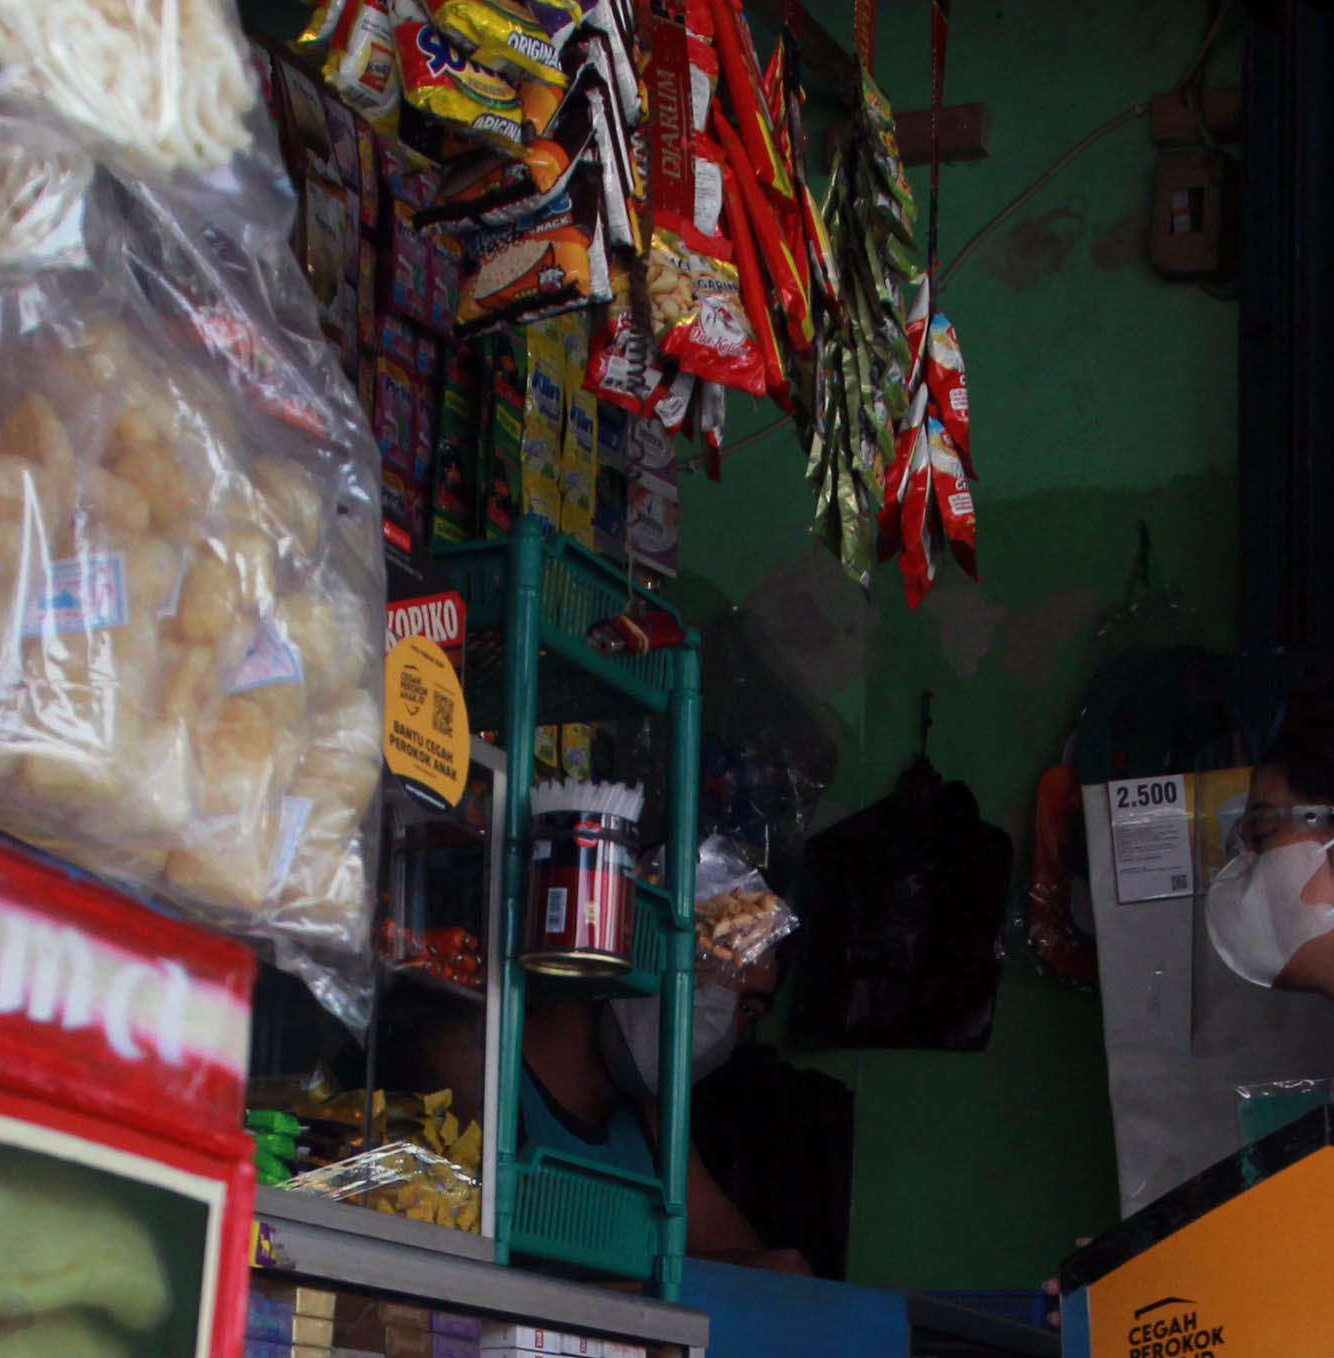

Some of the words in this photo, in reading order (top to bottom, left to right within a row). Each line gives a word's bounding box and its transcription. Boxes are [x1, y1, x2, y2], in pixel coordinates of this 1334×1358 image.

[507, 31, 562, 71] ORIGINA
[660, 67, 681, 180] DJARUM
[696, 279, 739, 291] GARIN
[386, 598, 459, 651] KOPIKO
[388, 733, 432, 768] PEROKOK
[433, 758, 459, 783] ANAK
[392, 719, 424, 747] BANTU
[425, 737, 454, 764] CEGAH
[1116, 781, 1177, 809] 2.500
[1128, 1312, 1198, 1346] CEGAH
